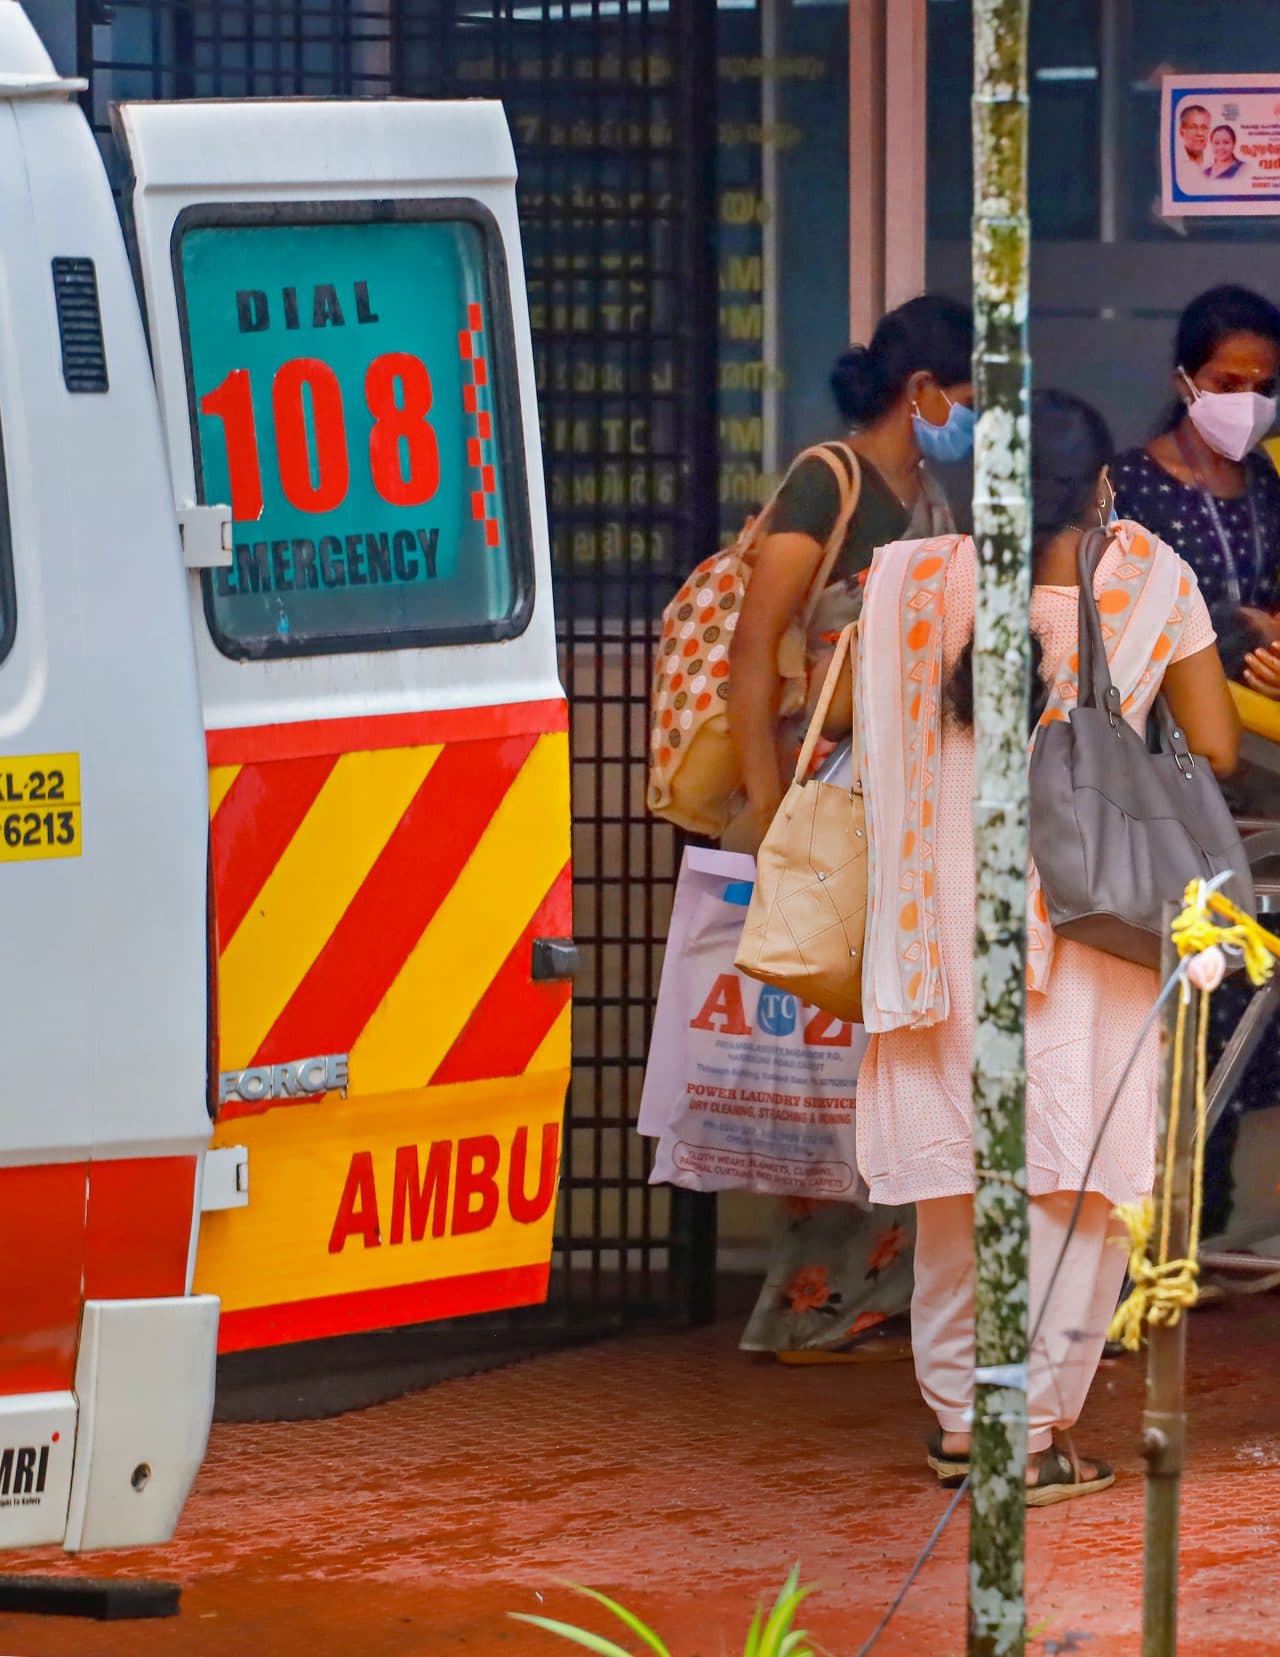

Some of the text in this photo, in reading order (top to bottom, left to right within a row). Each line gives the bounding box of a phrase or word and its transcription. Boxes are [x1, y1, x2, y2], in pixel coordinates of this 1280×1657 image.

[235, 281, 379, 333] DIAL
[200, 352, 440, 522] 108
[217, 528, 440, 597] EMERGENCY
[690, 973, 752, 1036] A
[801, 999, 852, 1047] Z
[219, 1054, 349, 1104] FORCE
[687, 1083, 737, 1100] POWER
[741, 1089, 801, 1107] LAUNDRY
[328, 1123, 560, 1254] AMBU
